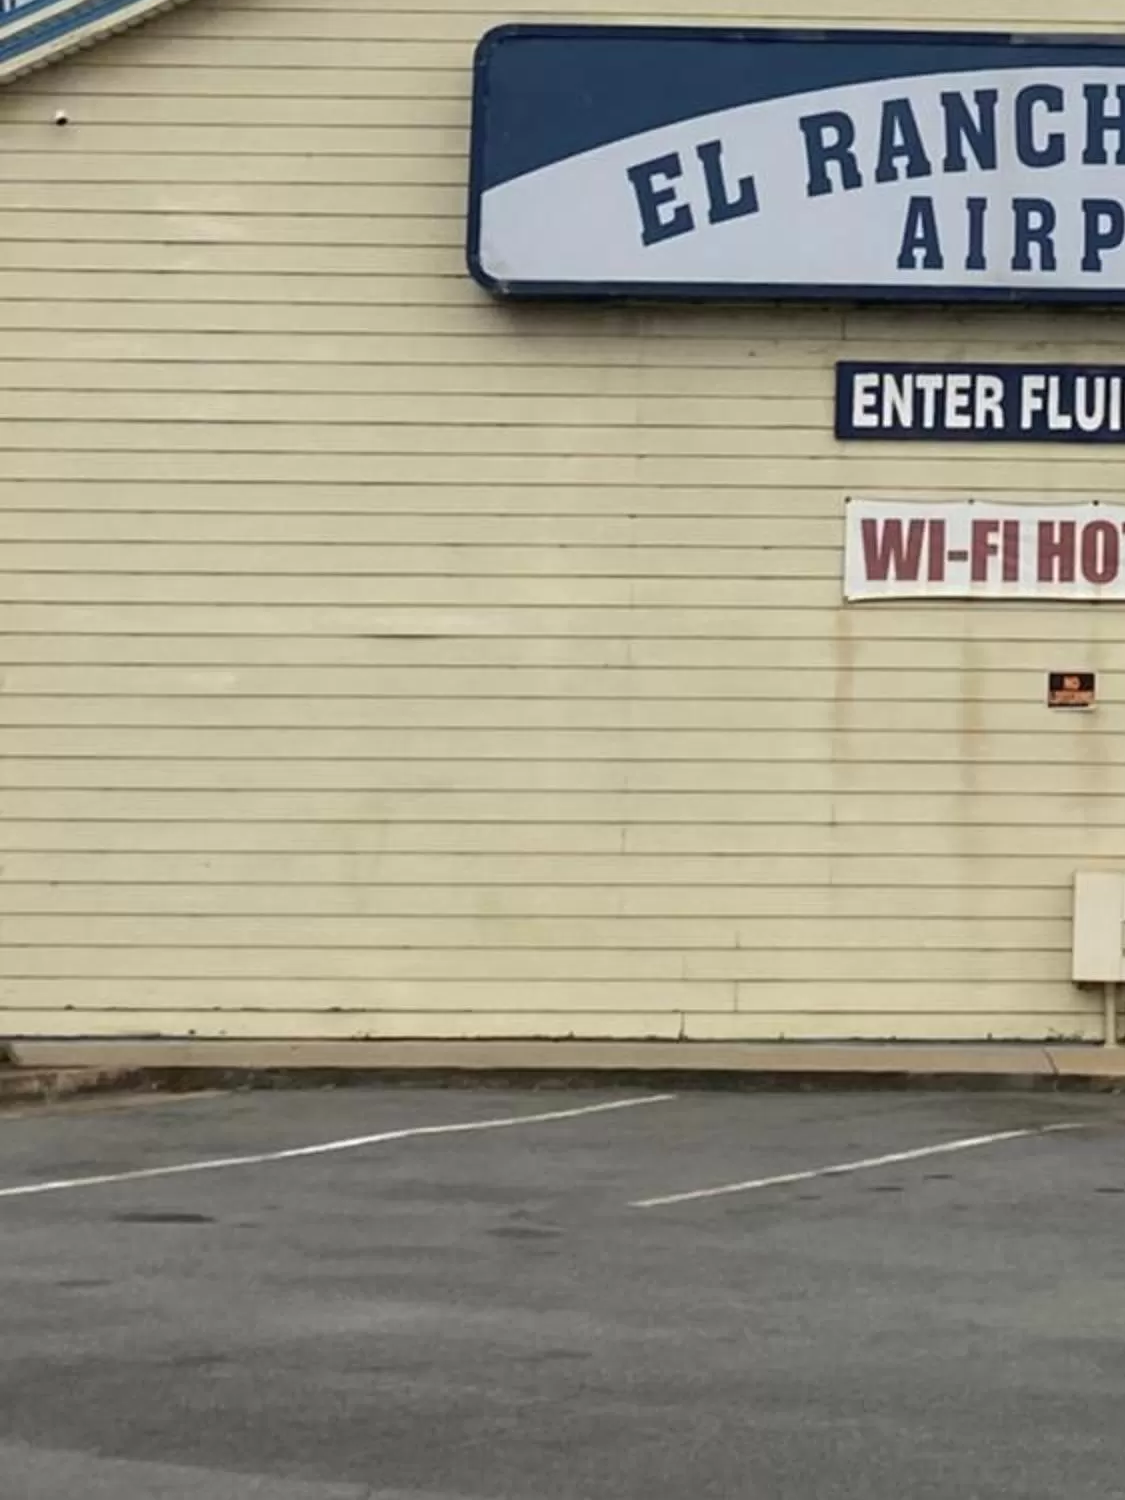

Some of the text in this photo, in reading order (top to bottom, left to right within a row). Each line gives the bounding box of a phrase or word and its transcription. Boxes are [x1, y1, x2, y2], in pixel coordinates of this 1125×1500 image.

[627, 152, 759, 246] EL
[852, 373, 1004, 429] ENTER
[861, 518, 1020, 582] WI-FI
